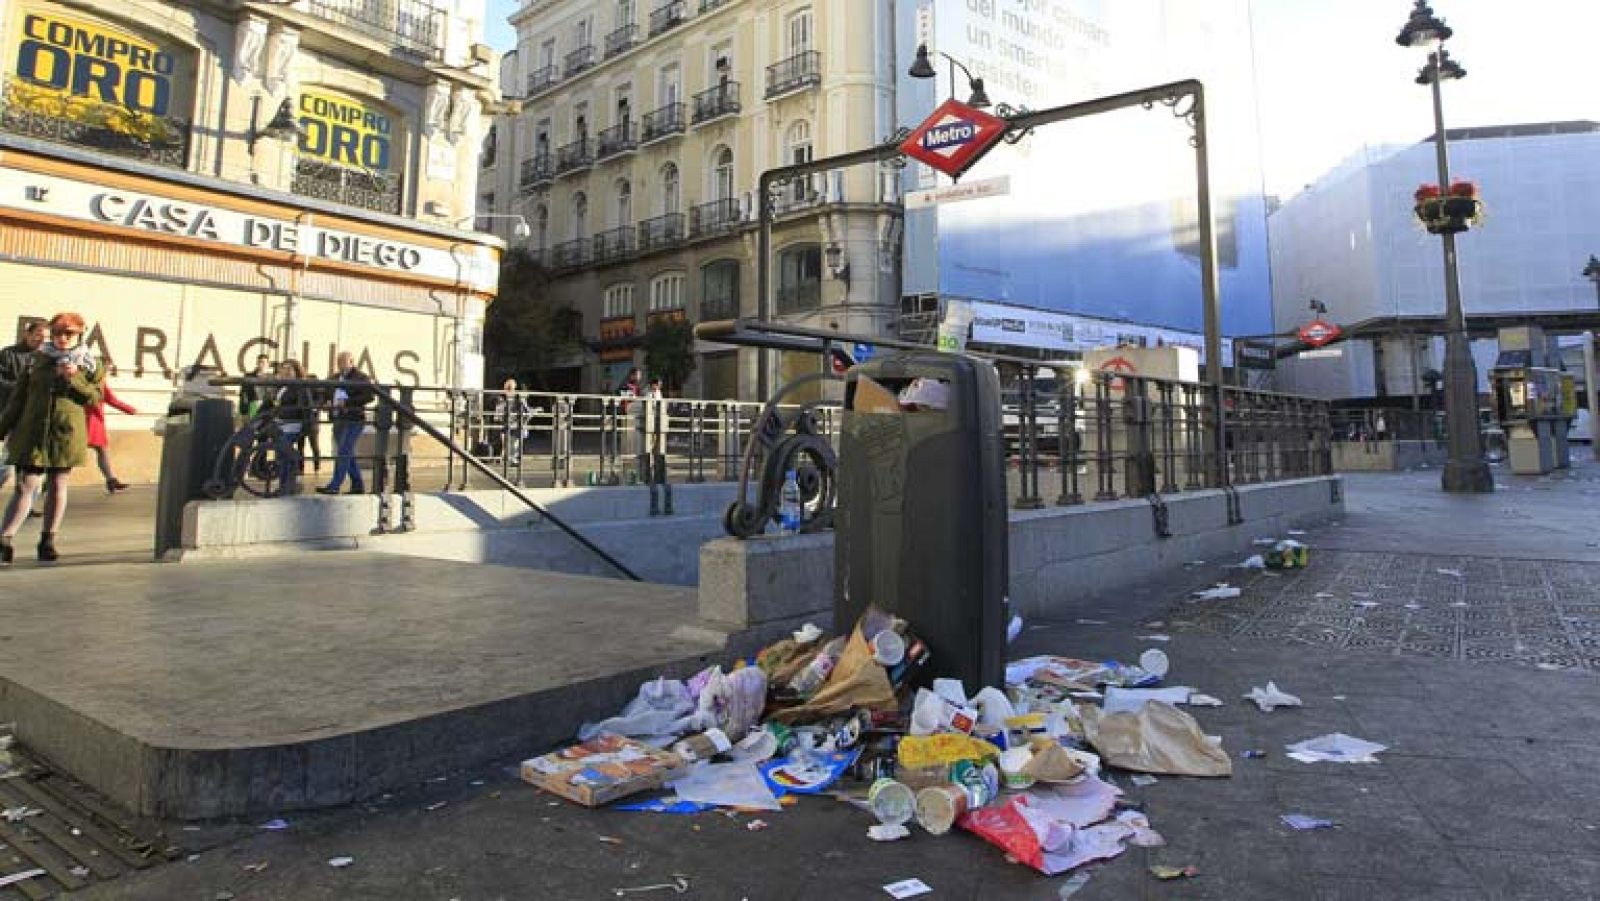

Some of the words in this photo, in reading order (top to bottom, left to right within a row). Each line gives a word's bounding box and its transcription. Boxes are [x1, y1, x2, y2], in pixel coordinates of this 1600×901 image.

[25, 14, 174, 74] COMPRO
[967, 24, 992, 50] un
[18, 39, 170, 116] ORO
[300, 93, 390, 134] COMPRO
[927, 125, 972, 146] Metro
[298, 117, 389, 169] ORO
[89, 193, 219, 240] CASA
[243, 218, 298, 251] DE
[316, 231, 421, 270] DIEGO
